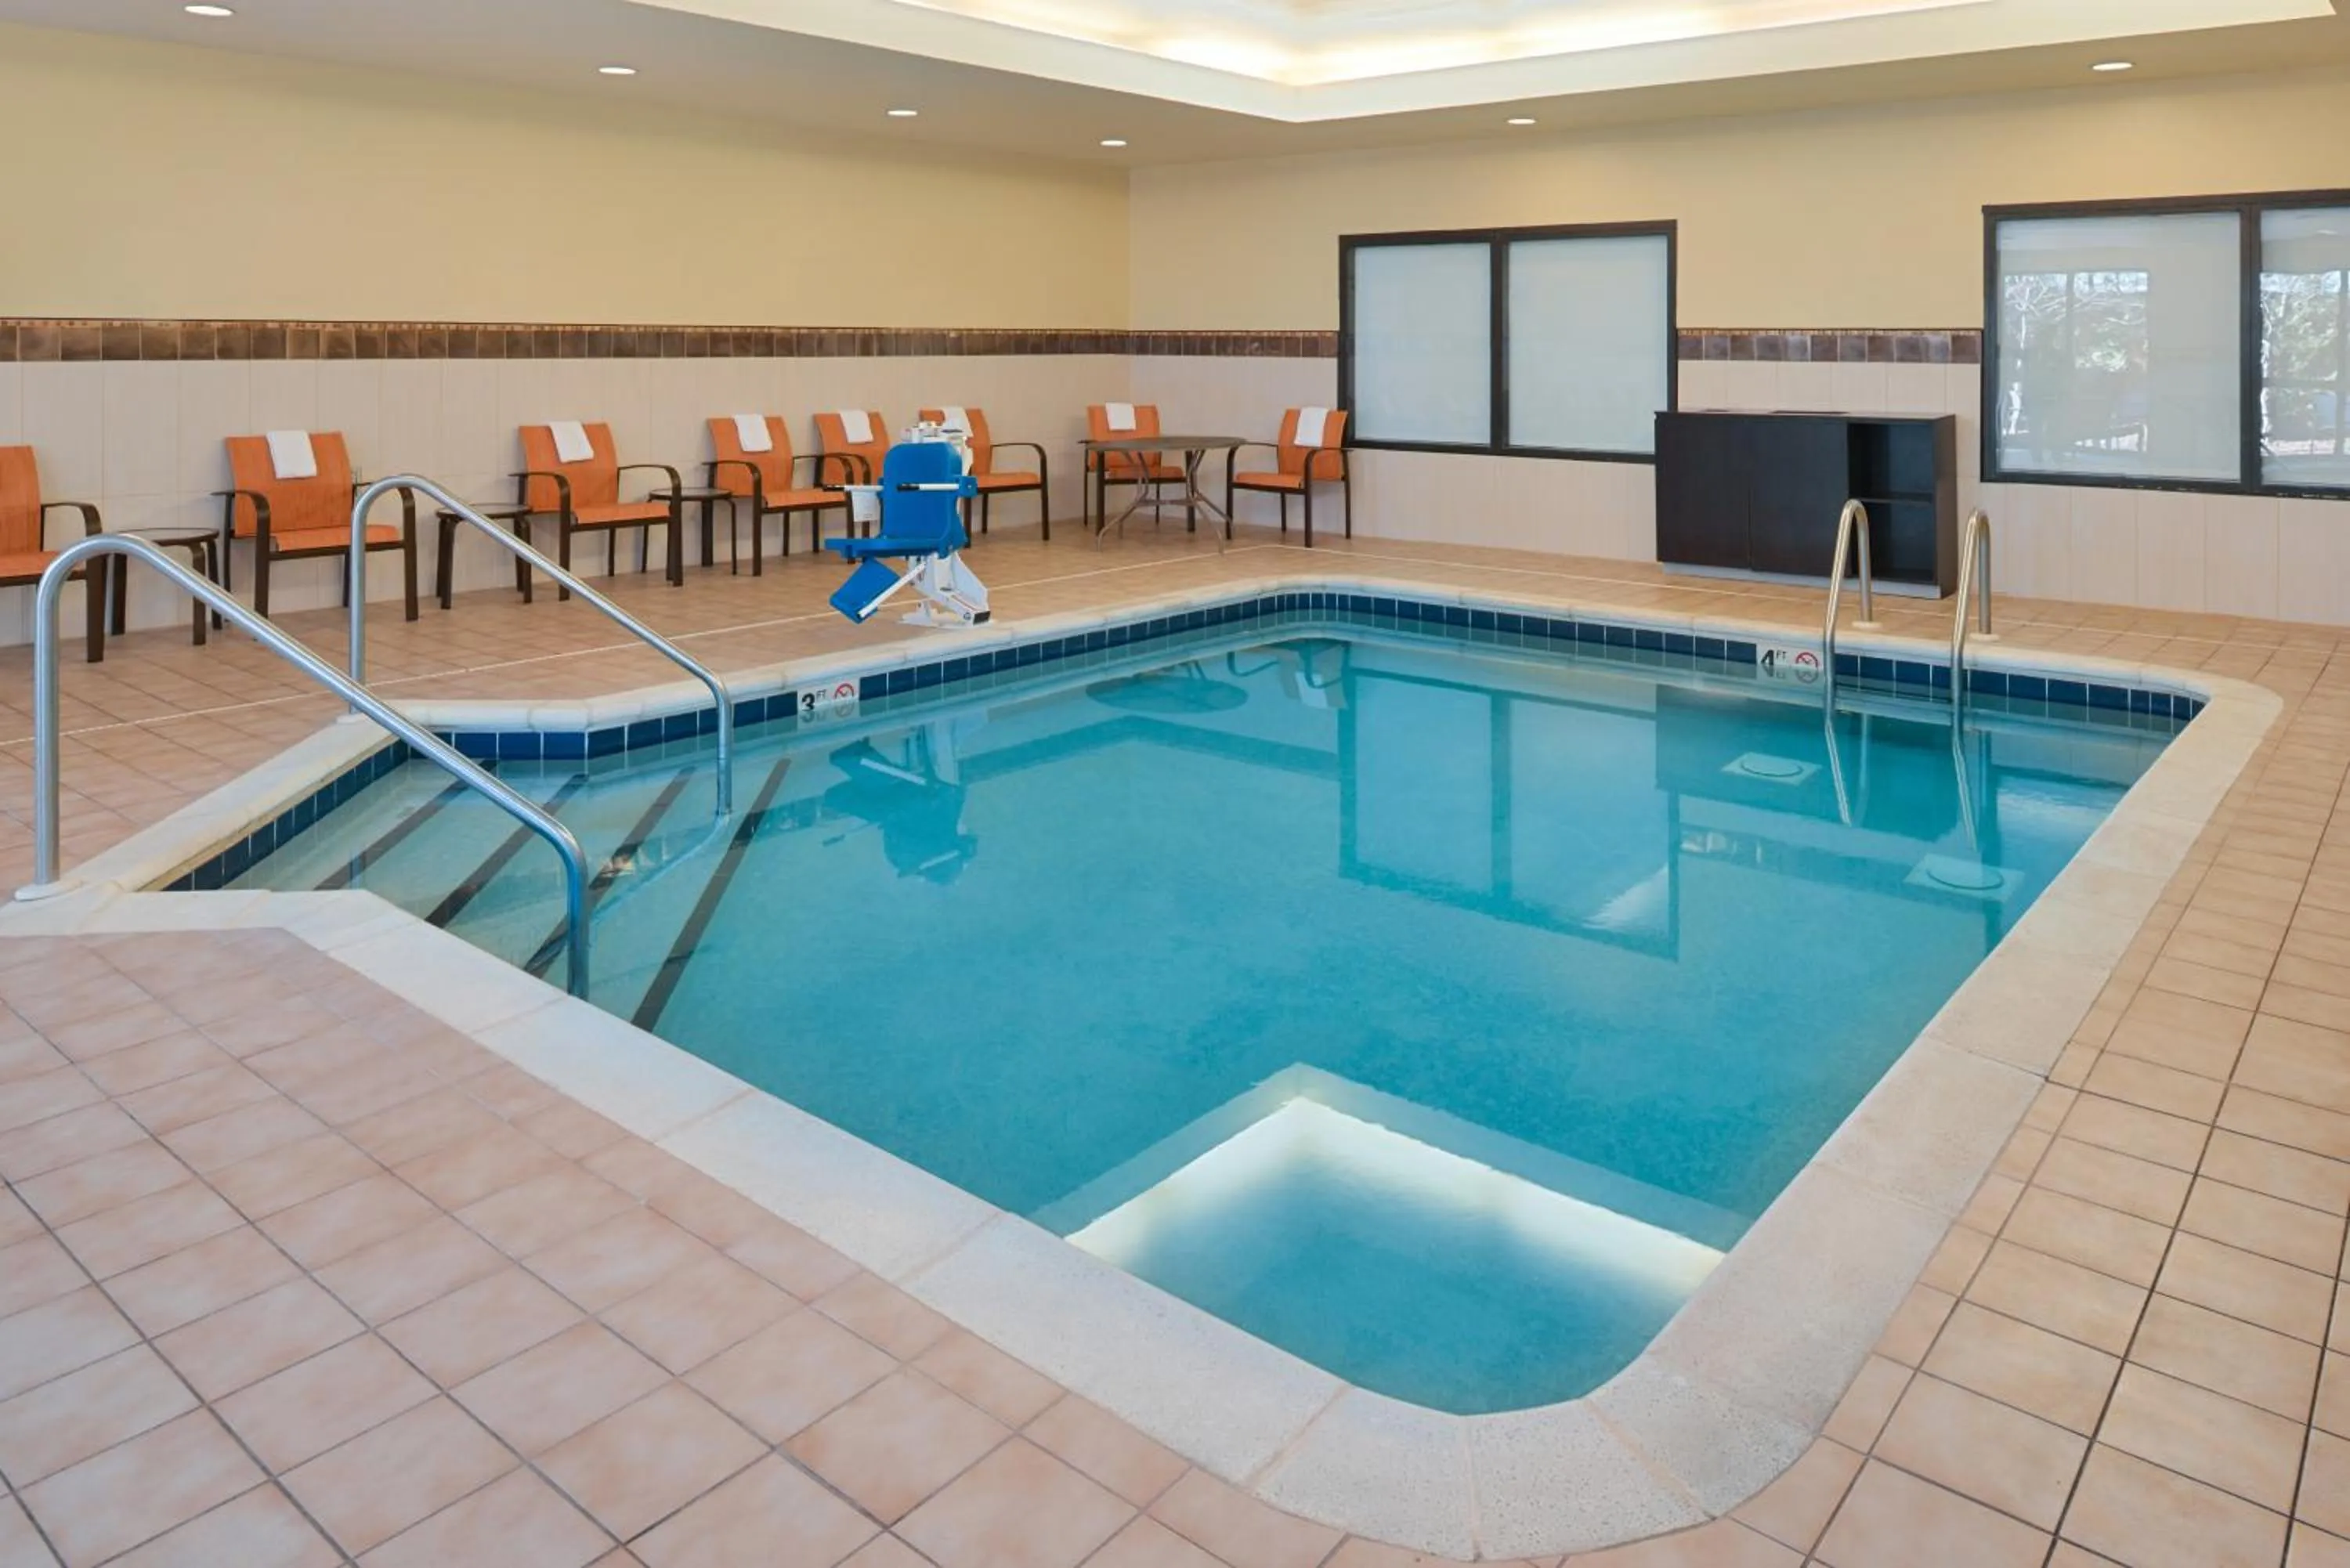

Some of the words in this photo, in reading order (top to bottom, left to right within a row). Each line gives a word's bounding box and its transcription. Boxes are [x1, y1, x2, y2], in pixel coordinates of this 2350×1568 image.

[1760, 649, 1774, 665] 4
[1776, 650, 1787, 659] FT
[801, 692, 815, 711] 3
[816, 689, 826, 699] FT
